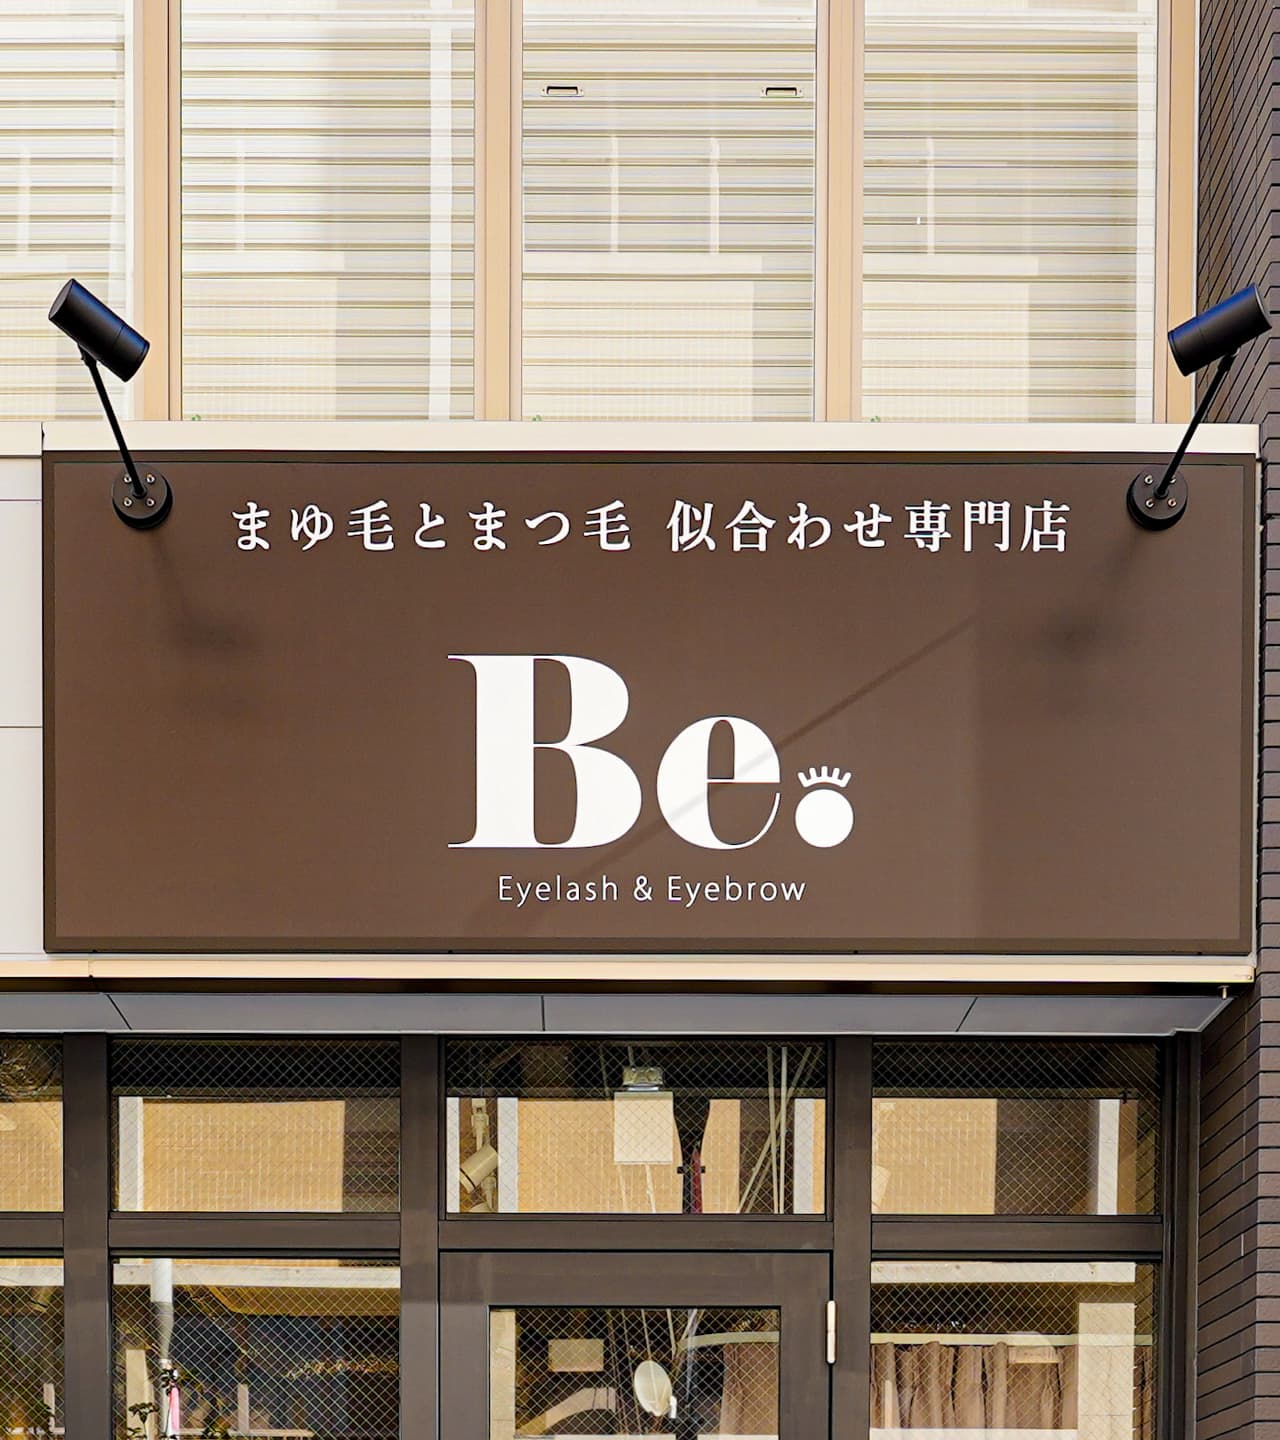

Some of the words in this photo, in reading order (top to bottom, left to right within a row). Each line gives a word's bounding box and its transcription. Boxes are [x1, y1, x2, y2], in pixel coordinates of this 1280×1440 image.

[232, 499, 632, 552] まゆ毛とまつ毛
[666, 499, 1071, 554] 似合わせ専門店
[499, 874, 618, 908] Eyelash
[633, 874, 653, 901] &
[668, 874, 806, 908] Eyebrow
